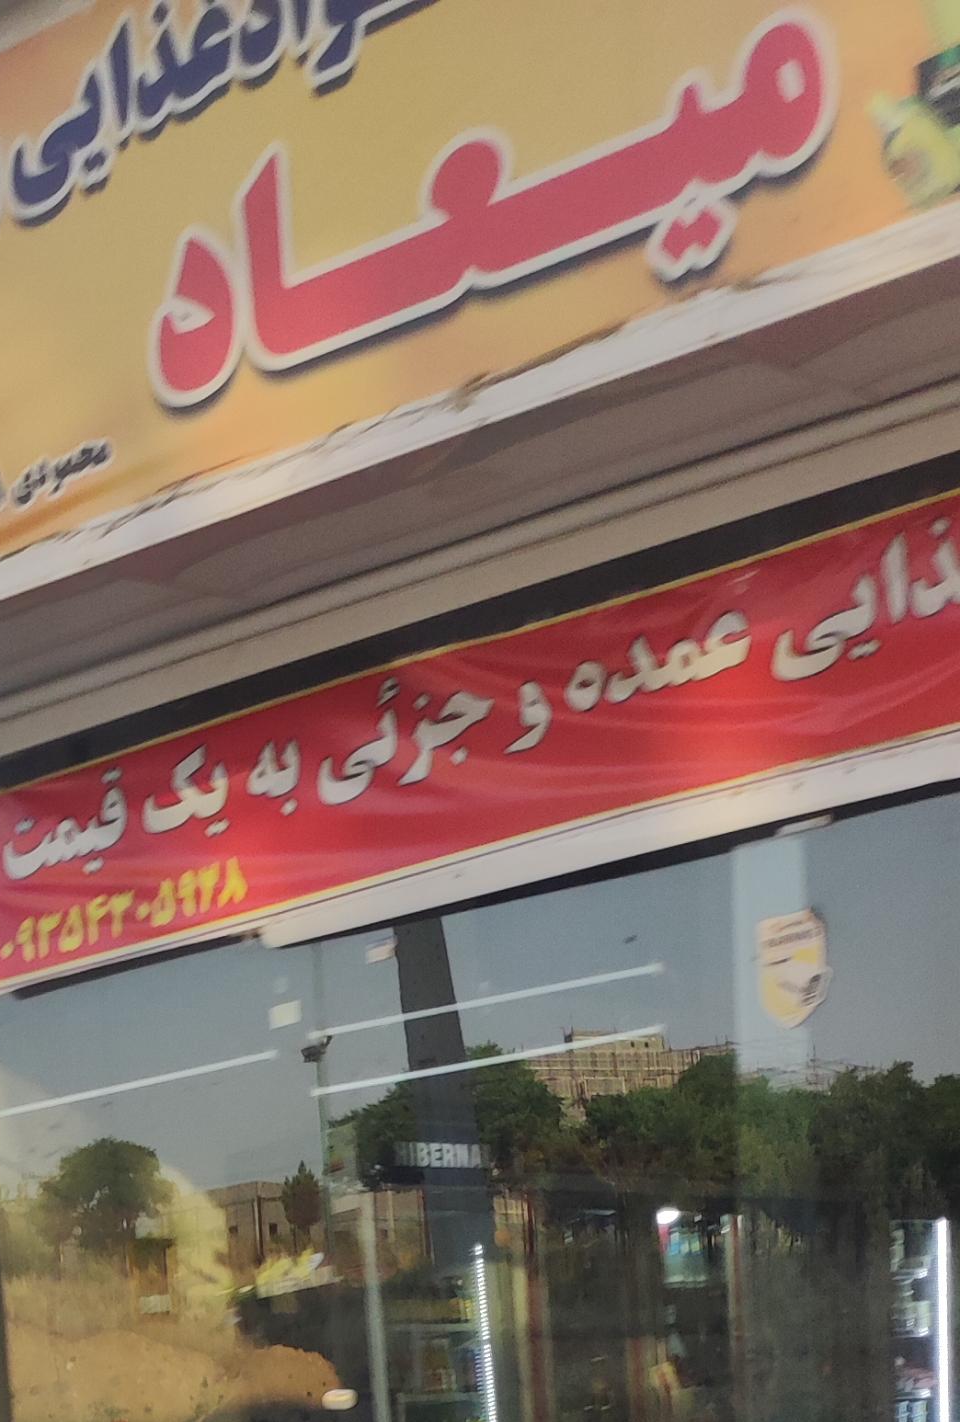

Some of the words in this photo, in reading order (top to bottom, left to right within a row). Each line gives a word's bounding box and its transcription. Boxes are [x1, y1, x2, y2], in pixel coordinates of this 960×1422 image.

[159, 20, 824, 394] میعاد
[772, 517, 960, 682] ذایی
[565, 608, 753, 711] عمده
[504, 680, 553, 755] و
[2, 767, 128, 880] قیمت
[143, 744, 230, 838] یک
[247, 740, 300, 816] به
